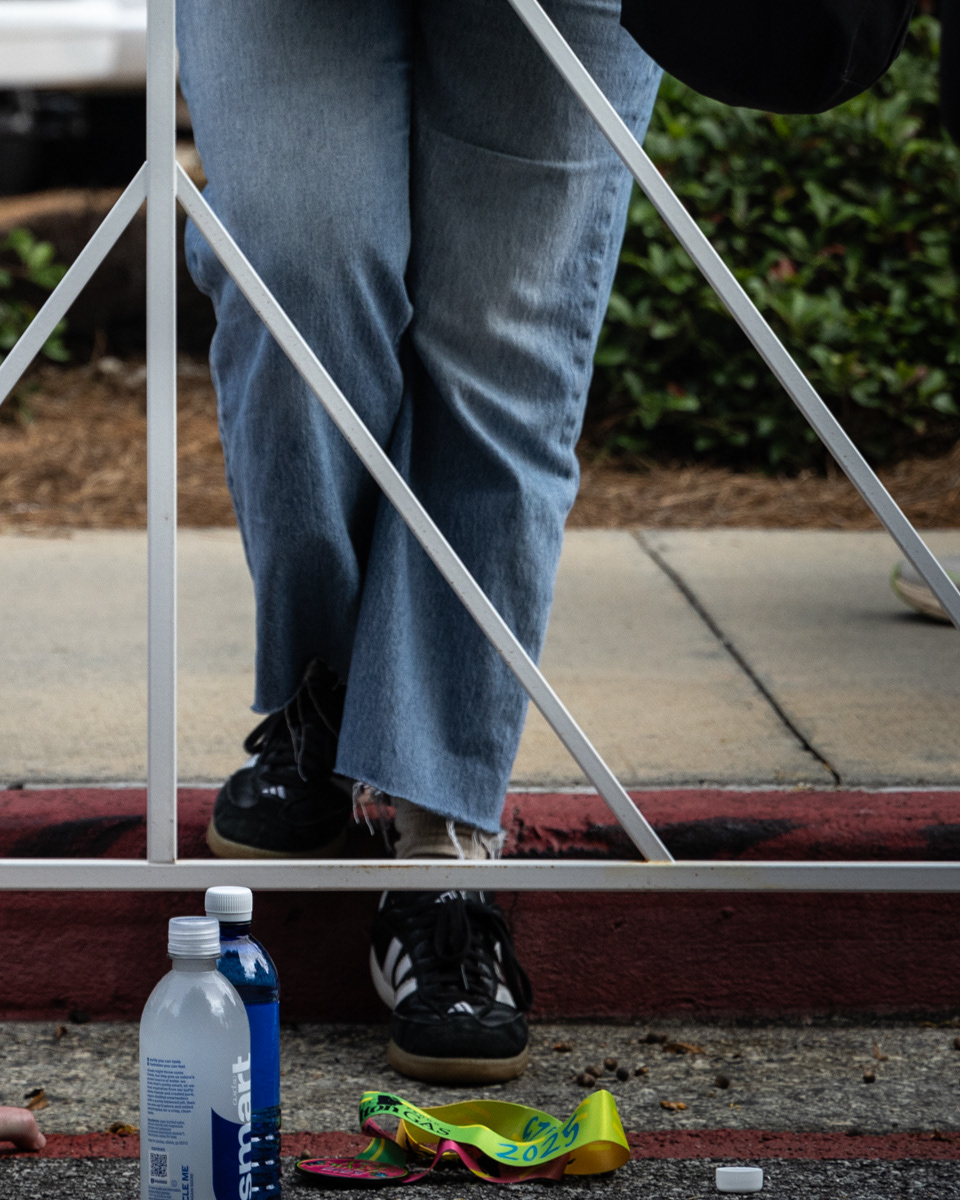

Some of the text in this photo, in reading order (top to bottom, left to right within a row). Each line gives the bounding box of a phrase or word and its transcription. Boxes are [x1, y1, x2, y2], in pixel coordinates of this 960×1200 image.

[232, 1052, 252, 1200] smart
[404, 1110, 451, 1136] GAS
[495, 1113, 580, 1162] 2025
[181, 1165, 189, 1182] ME
